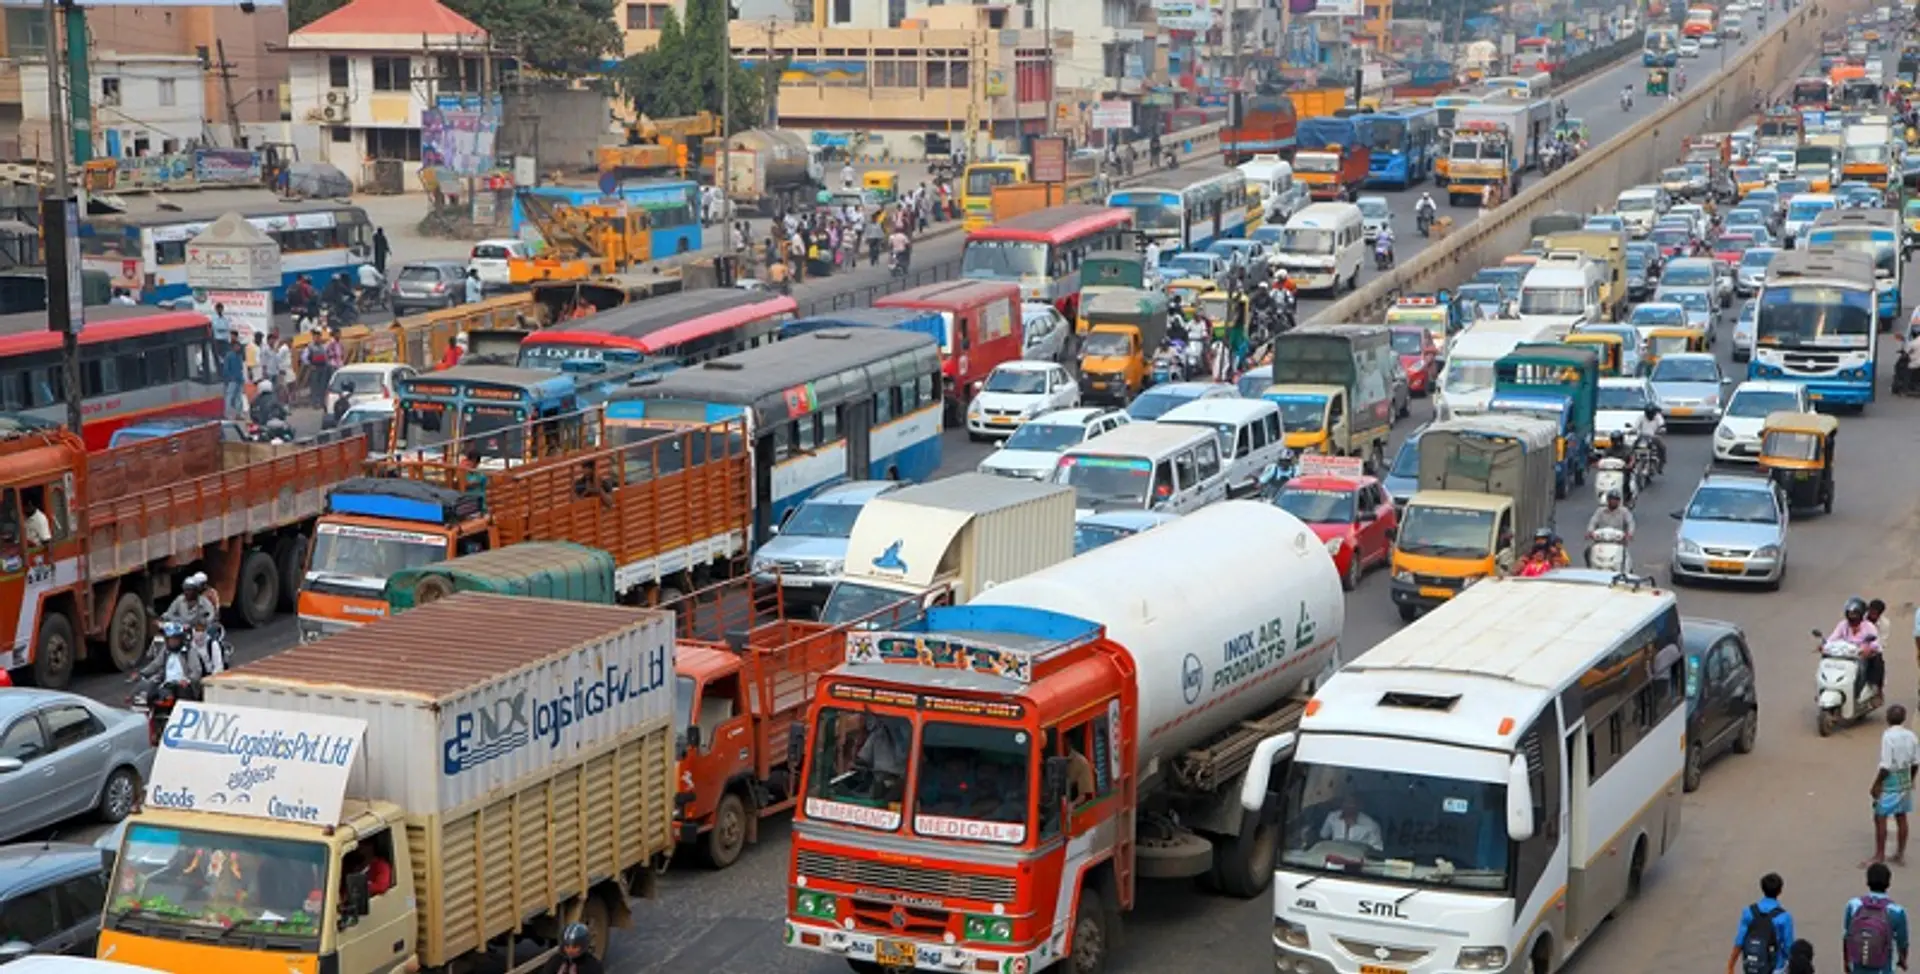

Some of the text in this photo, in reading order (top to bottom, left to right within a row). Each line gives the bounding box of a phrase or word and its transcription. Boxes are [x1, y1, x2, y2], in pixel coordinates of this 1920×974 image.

[1224, 617, 1282, 663] INOX AIR
[1212, 639, 1286, 692] PRODUCTS
[163, 706, 240, 748] PNX
[532, 677, 605, 748] logistics
[153, 785, 320, 820] Goods Carrier
[820, 801, 897, 827] EMERGENCY
[918, 817, 1005, 840] MEDICAL
[1358, 899, 1409, 919] SML
